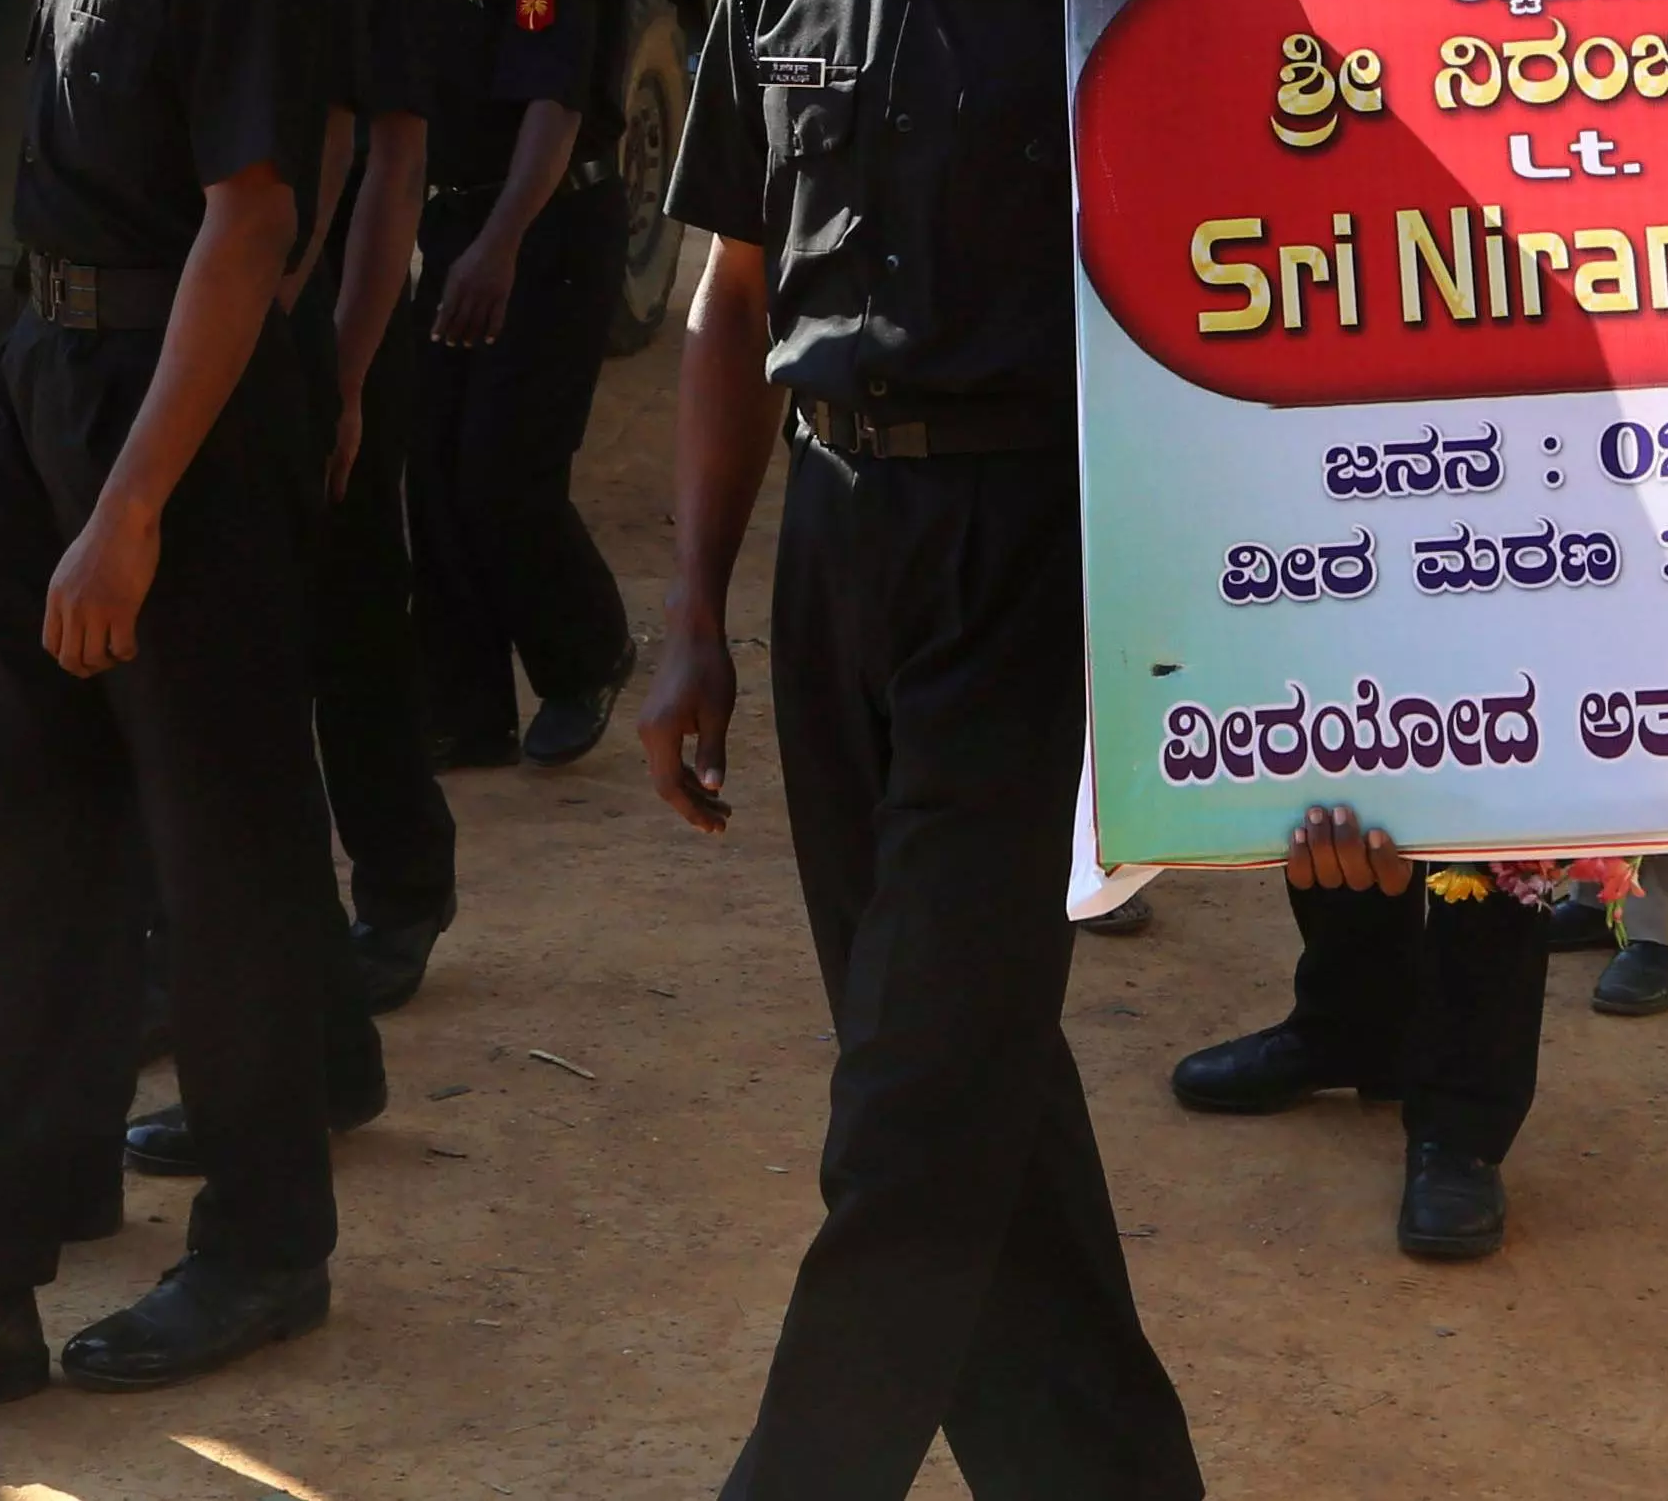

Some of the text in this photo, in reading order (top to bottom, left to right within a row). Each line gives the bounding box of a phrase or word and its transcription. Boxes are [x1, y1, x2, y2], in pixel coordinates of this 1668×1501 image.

[1270, 32, 1382, 147] ಶ್ರೀ
[1509, 129, 1641, 179] Lt.
[1190, 212, 1358, 334] Sri
[1325, 421, 1500, 497] ಜನನ
[1221, 524, 1376, 602] ವೀರ
[1413, 516, 1620, 594] ಮರಣ
